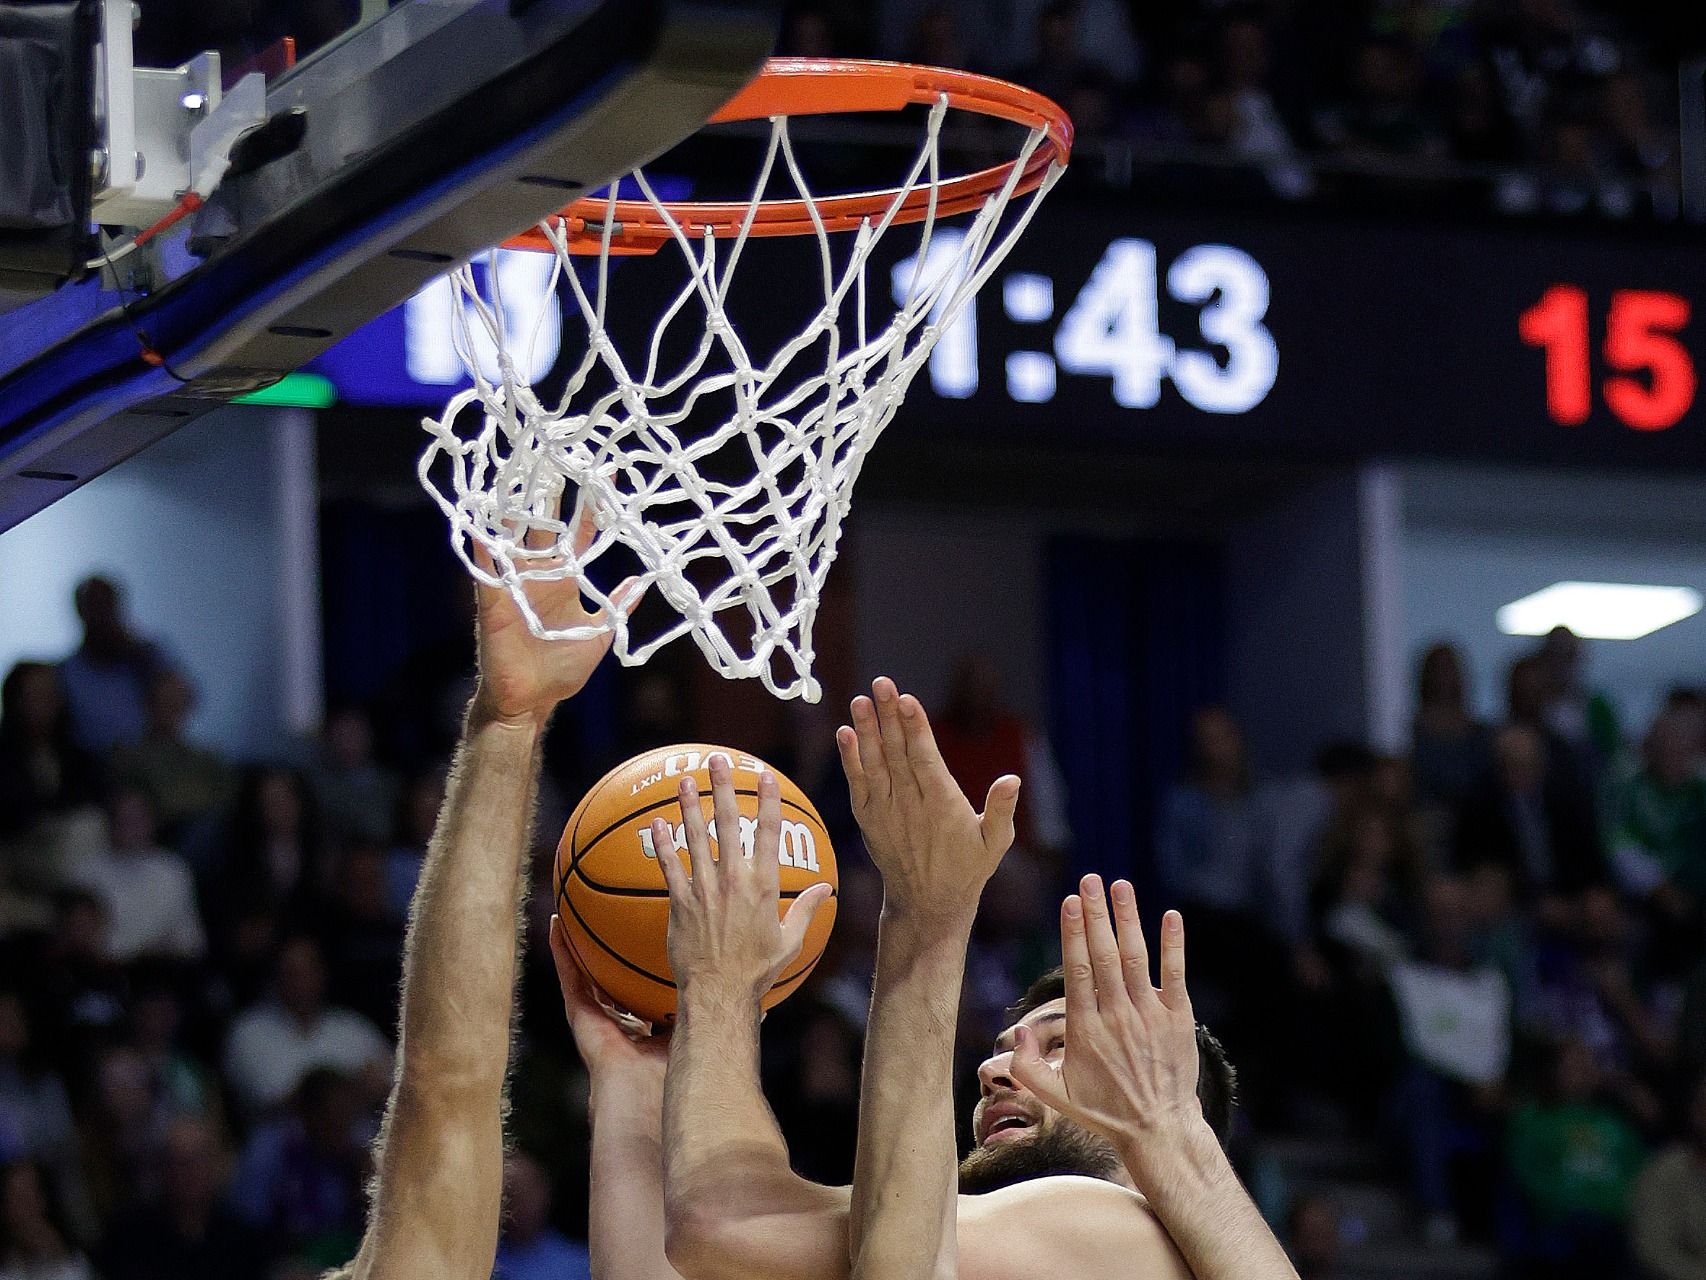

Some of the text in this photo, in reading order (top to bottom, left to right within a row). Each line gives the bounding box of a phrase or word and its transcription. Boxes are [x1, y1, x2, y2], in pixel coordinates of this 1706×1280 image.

[890, 226, 1280, 415] 1:43
[1518, 281, 1698, 432] 15
[629, 772, 662, 797] NXT
